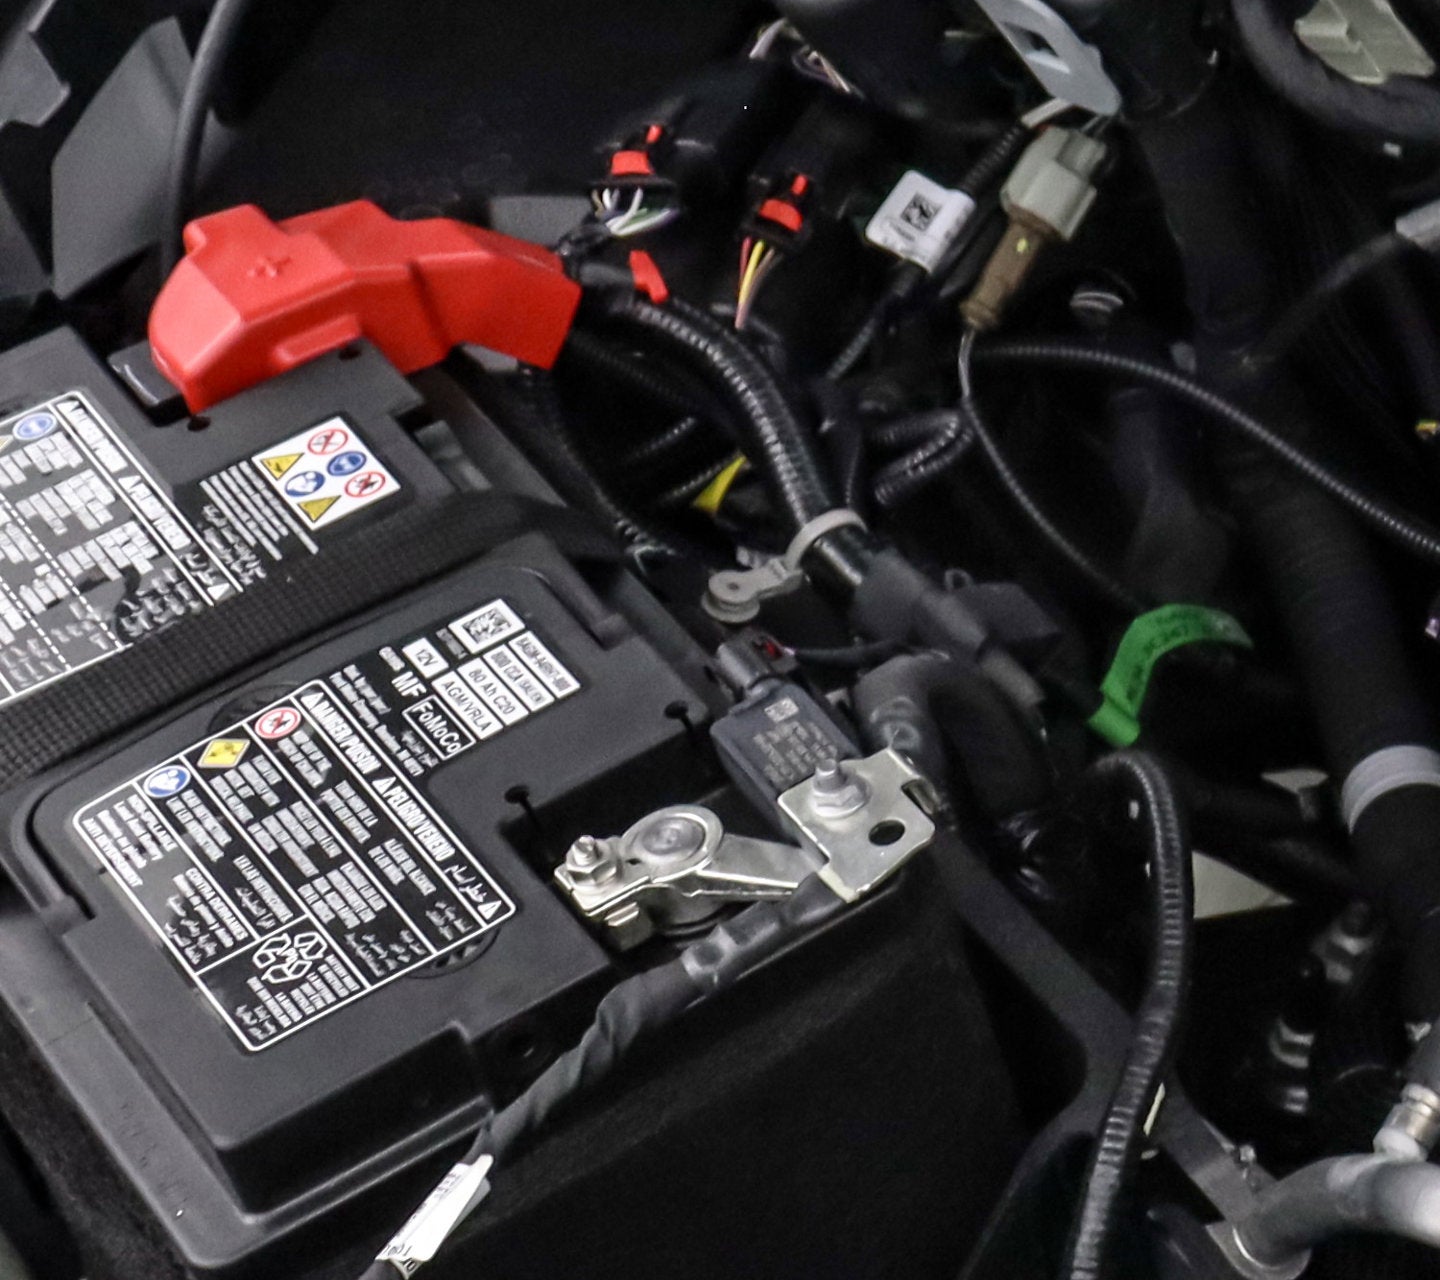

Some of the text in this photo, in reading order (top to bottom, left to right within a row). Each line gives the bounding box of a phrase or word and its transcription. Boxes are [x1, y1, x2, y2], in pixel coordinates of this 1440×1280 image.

[391, 671, 427, 697] MF
[439, 678, 494, 732] AGM/VRLA
[410, 700, 463, 754] FoMoCo
